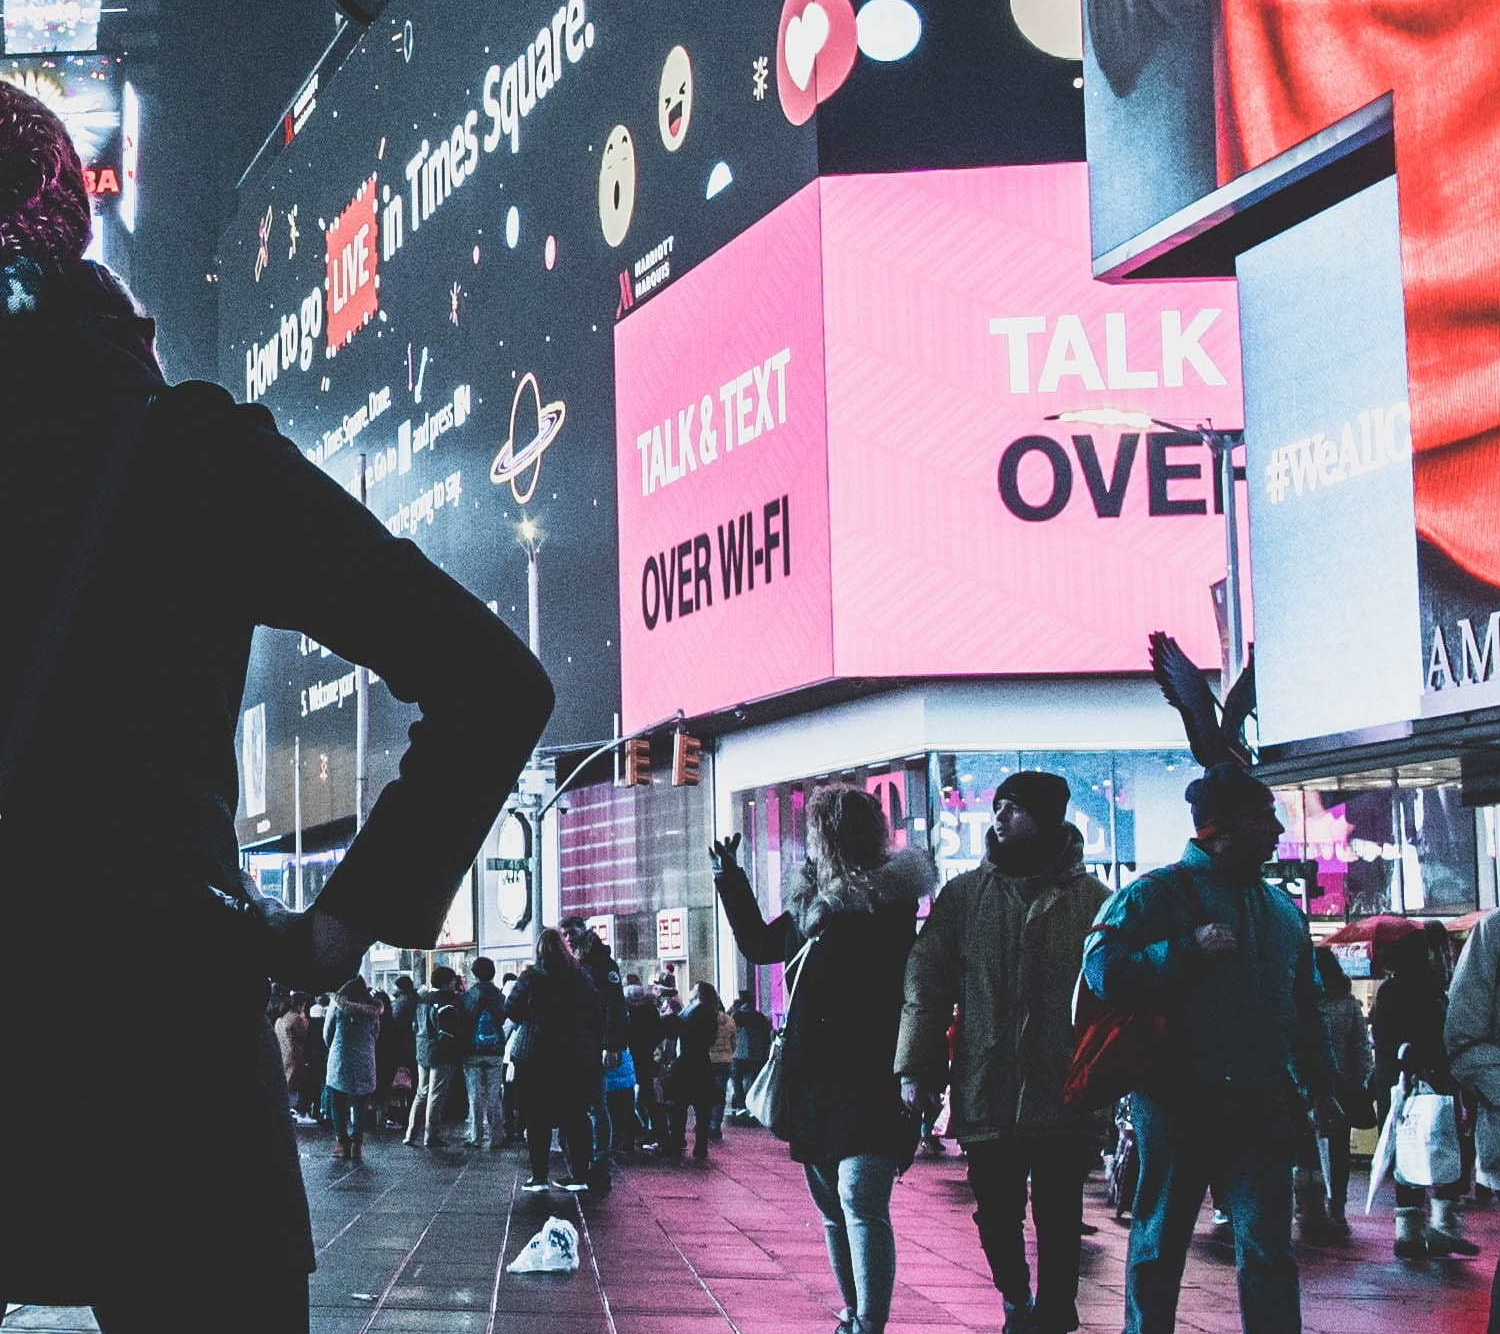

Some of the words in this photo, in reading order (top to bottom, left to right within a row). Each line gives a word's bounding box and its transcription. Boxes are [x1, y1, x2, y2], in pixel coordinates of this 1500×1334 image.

[246, 332, 279, 403] How
[280, 313, 298, 371] to
[300, 286, 322, 371] go
[331, 238, 371, 316] LIVE
[382, 182, 403, 262] in
[407, 115, 478, 232] Times
[989, 308, 1227, 395] TALK
[636, 429, 696, 498] TALK
[698, 399, 718, 462] &
[719, 349, 791, 444] TEXT
[641, 536, 712, 632] OVER
[716, 495, 791, 599] WI-FI
